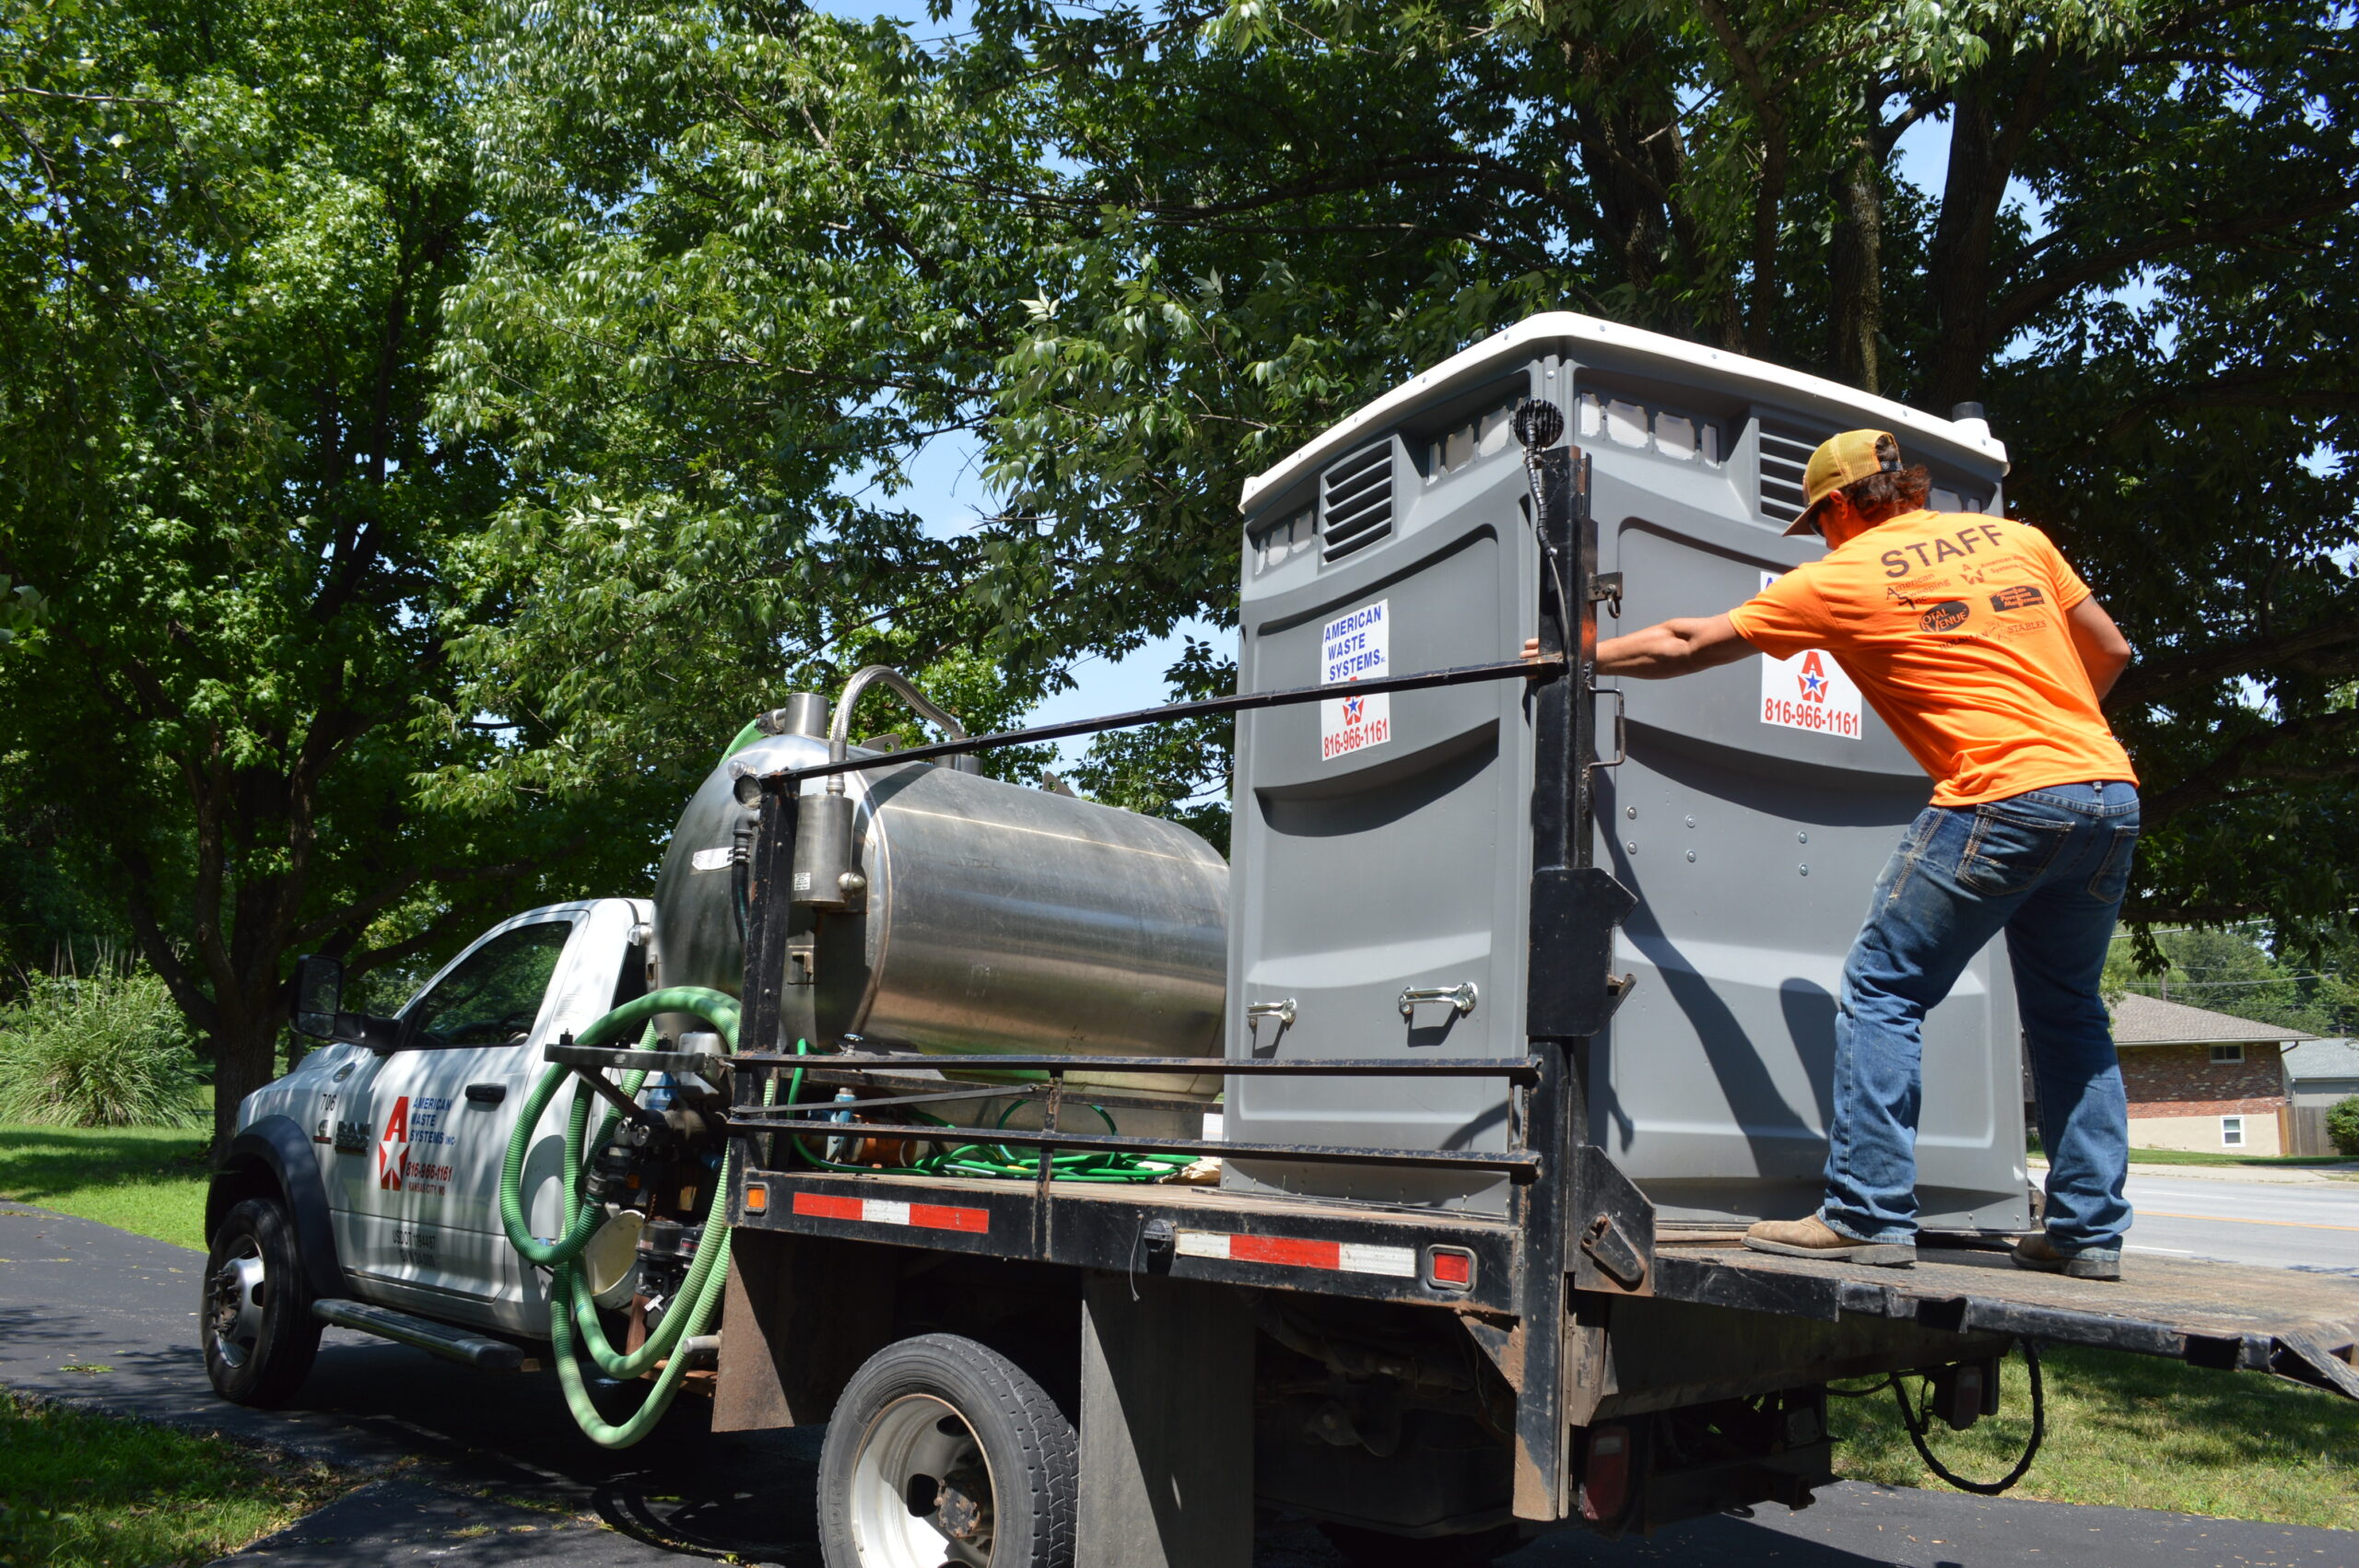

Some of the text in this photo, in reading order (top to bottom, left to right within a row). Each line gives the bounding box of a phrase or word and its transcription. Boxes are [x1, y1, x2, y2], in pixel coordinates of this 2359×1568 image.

[1881, 524, 2003, 579] STAFF
[1886, 573, 1935, 601] American
[1325, 605, 1382, 643] AMERICAN
[2008, 620, 2048, 634] STABLES
[1328, 633, 1366, 661] WASTE
[1330, 649, 1380, 681] SYSTEMS
[1765, 697, 1859, 736] 816-966-1161
[1324, 718, 1388, 757] 816-966-1161
[321, 1094, 337, 1111] 706
[413, 1097, 452, 1111] AMERICAN
[411, 1113, 436, 1127] WASTE
[410, 1129, 444, 1144] SYSTEMS
[405, 1162, 452, 1181] 816-966-1161
